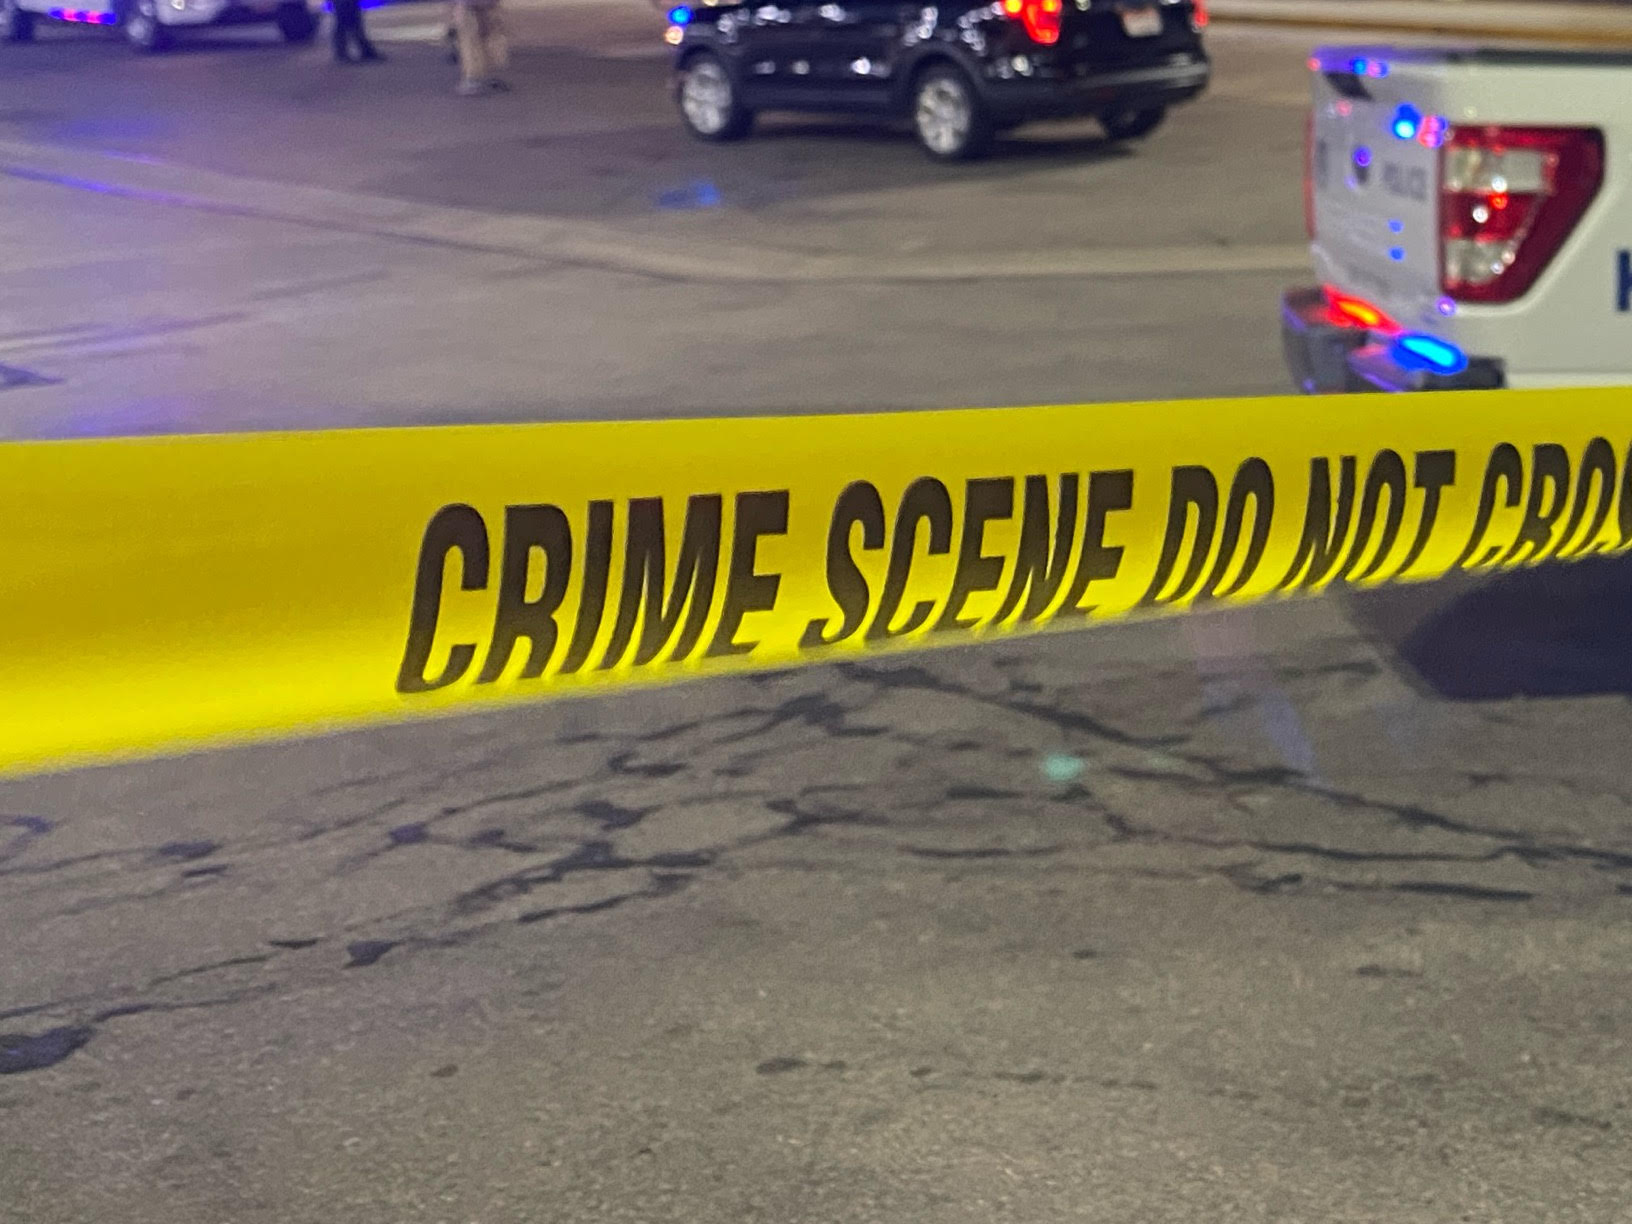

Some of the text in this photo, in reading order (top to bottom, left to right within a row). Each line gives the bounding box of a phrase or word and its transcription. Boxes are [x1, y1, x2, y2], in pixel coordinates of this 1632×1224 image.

[396, 489, 790, 694] CRIME
[799, 468, 1135, 649] SCENE
[1137, 456, 1276, 602] DO
[1278, 448, 1457, 592] NOT
